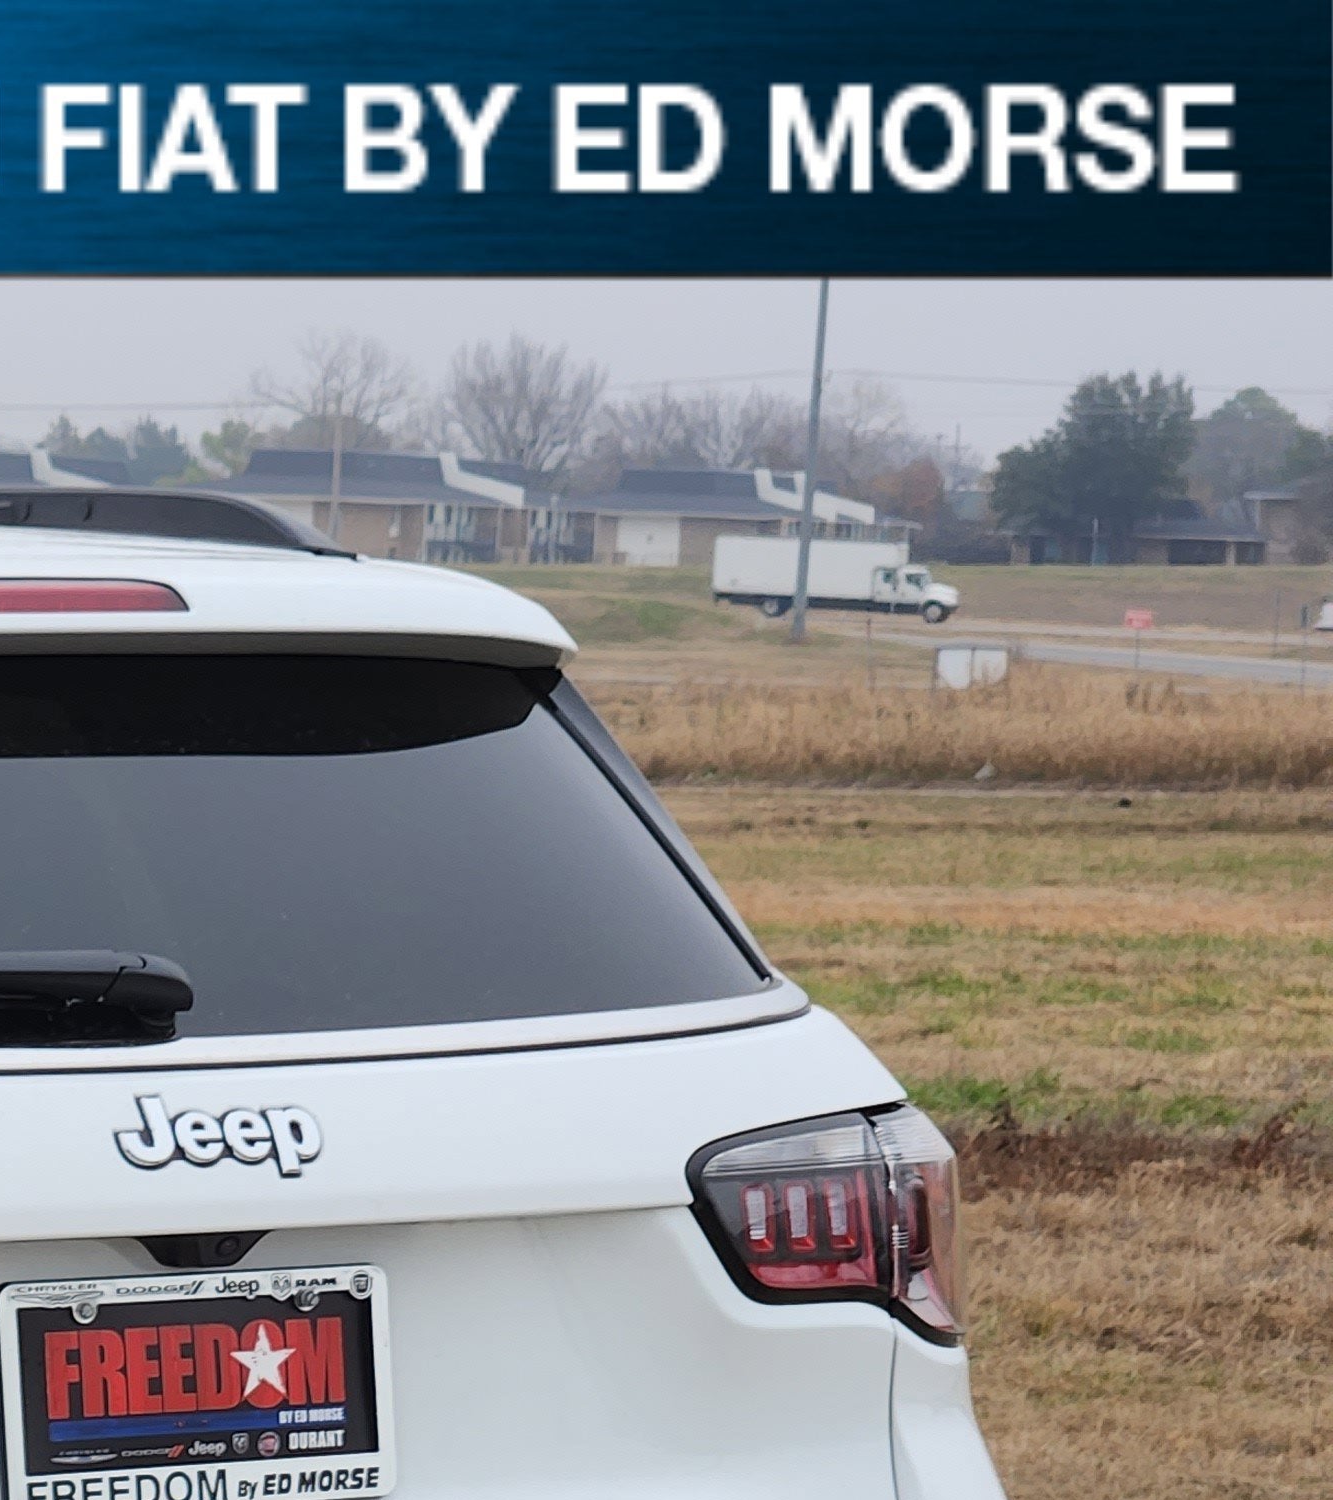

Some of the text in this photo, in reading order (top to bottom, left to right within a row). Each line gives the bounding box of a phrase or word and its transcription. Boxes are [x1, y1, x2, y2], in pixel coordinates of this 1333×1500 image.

[113, 1094, 323, 1178] Jeep
[215, 1276, 260, 1296] Jeep
[294, 1277, 337, 1287] RAM
[44, 1317, 346, 1419] FREEDOM
[187, 1440, 227, 1457] Jeep
[288, 1429, 345, 1450] DURANT
[263, 1473, 292, 1496] ED
[297, 1467, 380, 1493] MORSE
